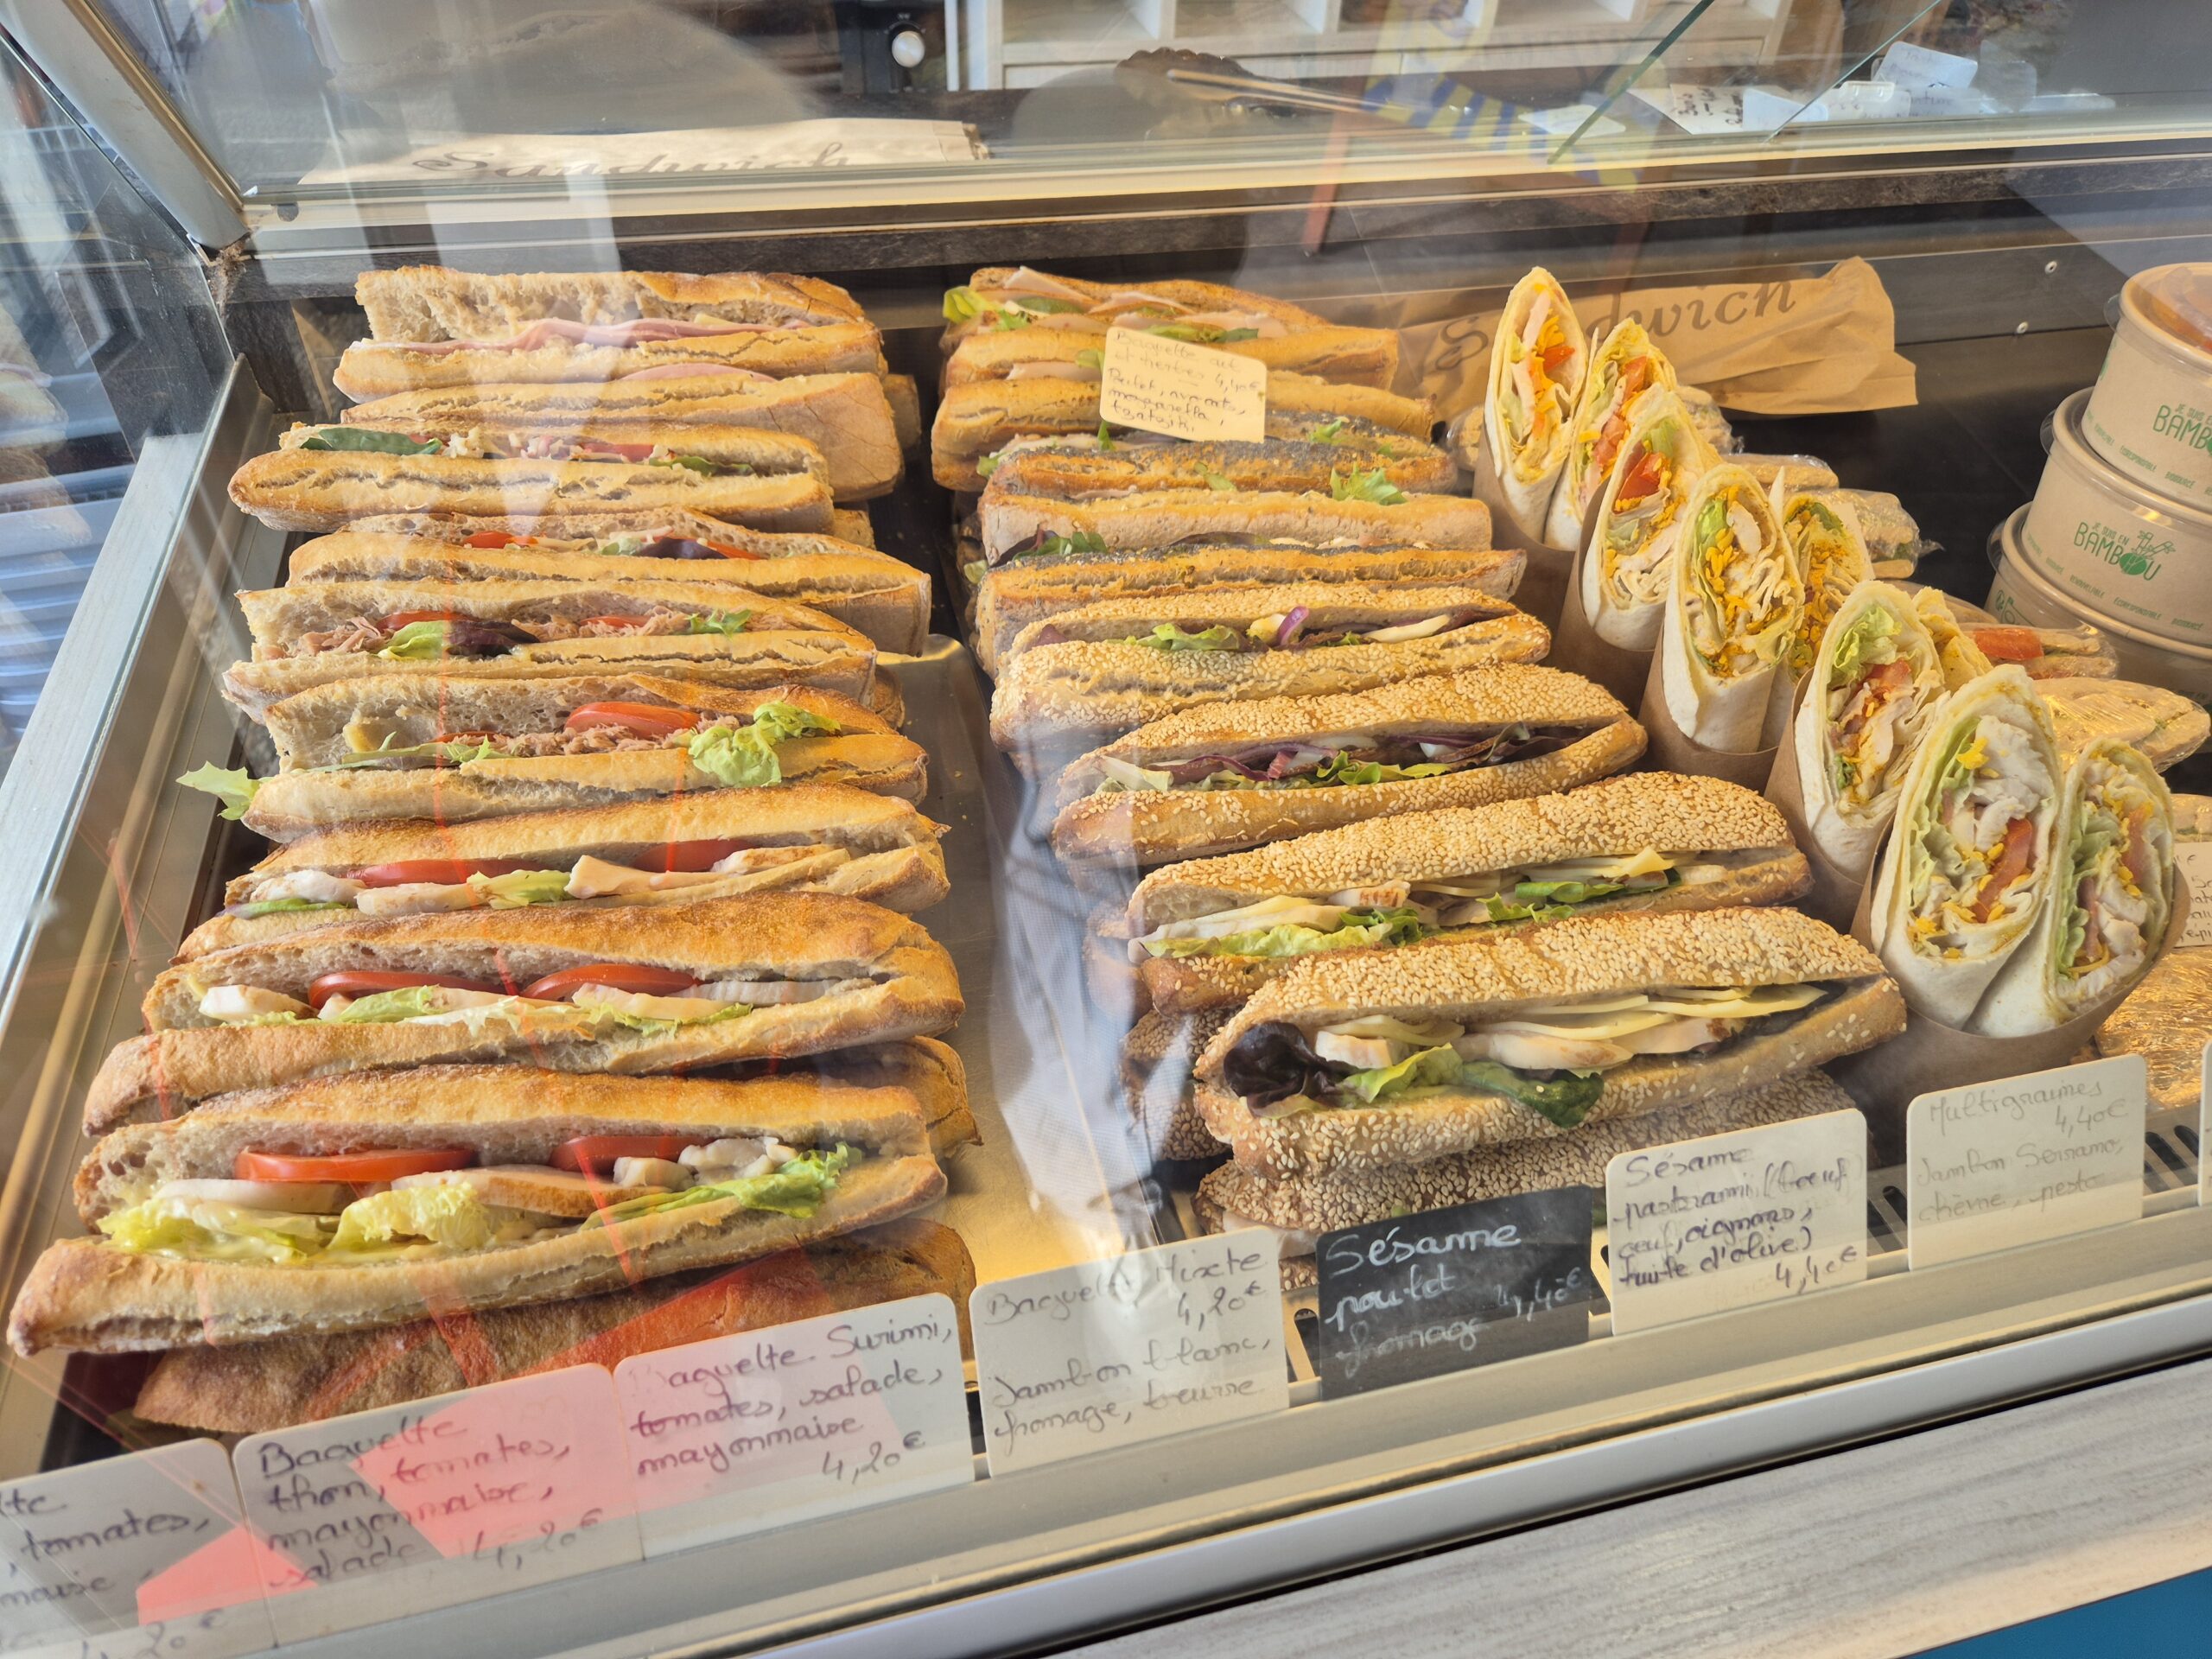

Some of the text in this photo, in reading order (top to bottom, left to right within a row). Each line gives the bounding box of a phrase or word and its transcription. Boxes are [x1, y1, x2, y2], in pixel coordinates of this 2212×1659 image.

[412, 142, 851, 178] Sandwich
[1434, 280, 1797, 372] Sdwich
[2152, 404, 2212, 456] BAMB
[2073, 521, 2162, 582] BAMBOU
[2101, 526, 2117, 540] SUIS
[2118, 534, 2130, 546] EN
[2054, 1097, 2130, 1139] 4,40€
[1625, 1148, 1754, 1188] Sésame
[1916, 1148, 2005, 1187] Jambon
[2029, 1168, 2105, 1213] pesto
[1325, 1224, 1522, 1280] Sésame
[984, 1260, 1136, 1325] Bague
[1177, 1281, 1267, 1332] 4,20€
[1324, 1263, 1458, 1332] poulet
[989, 1357, 1132, 1408] Jambon
[259, 1415, 468, 1480] Baguette
[995, 1401, 1133, 1459] fromage,
[822, 1429, 926, 1484] 4,20€
